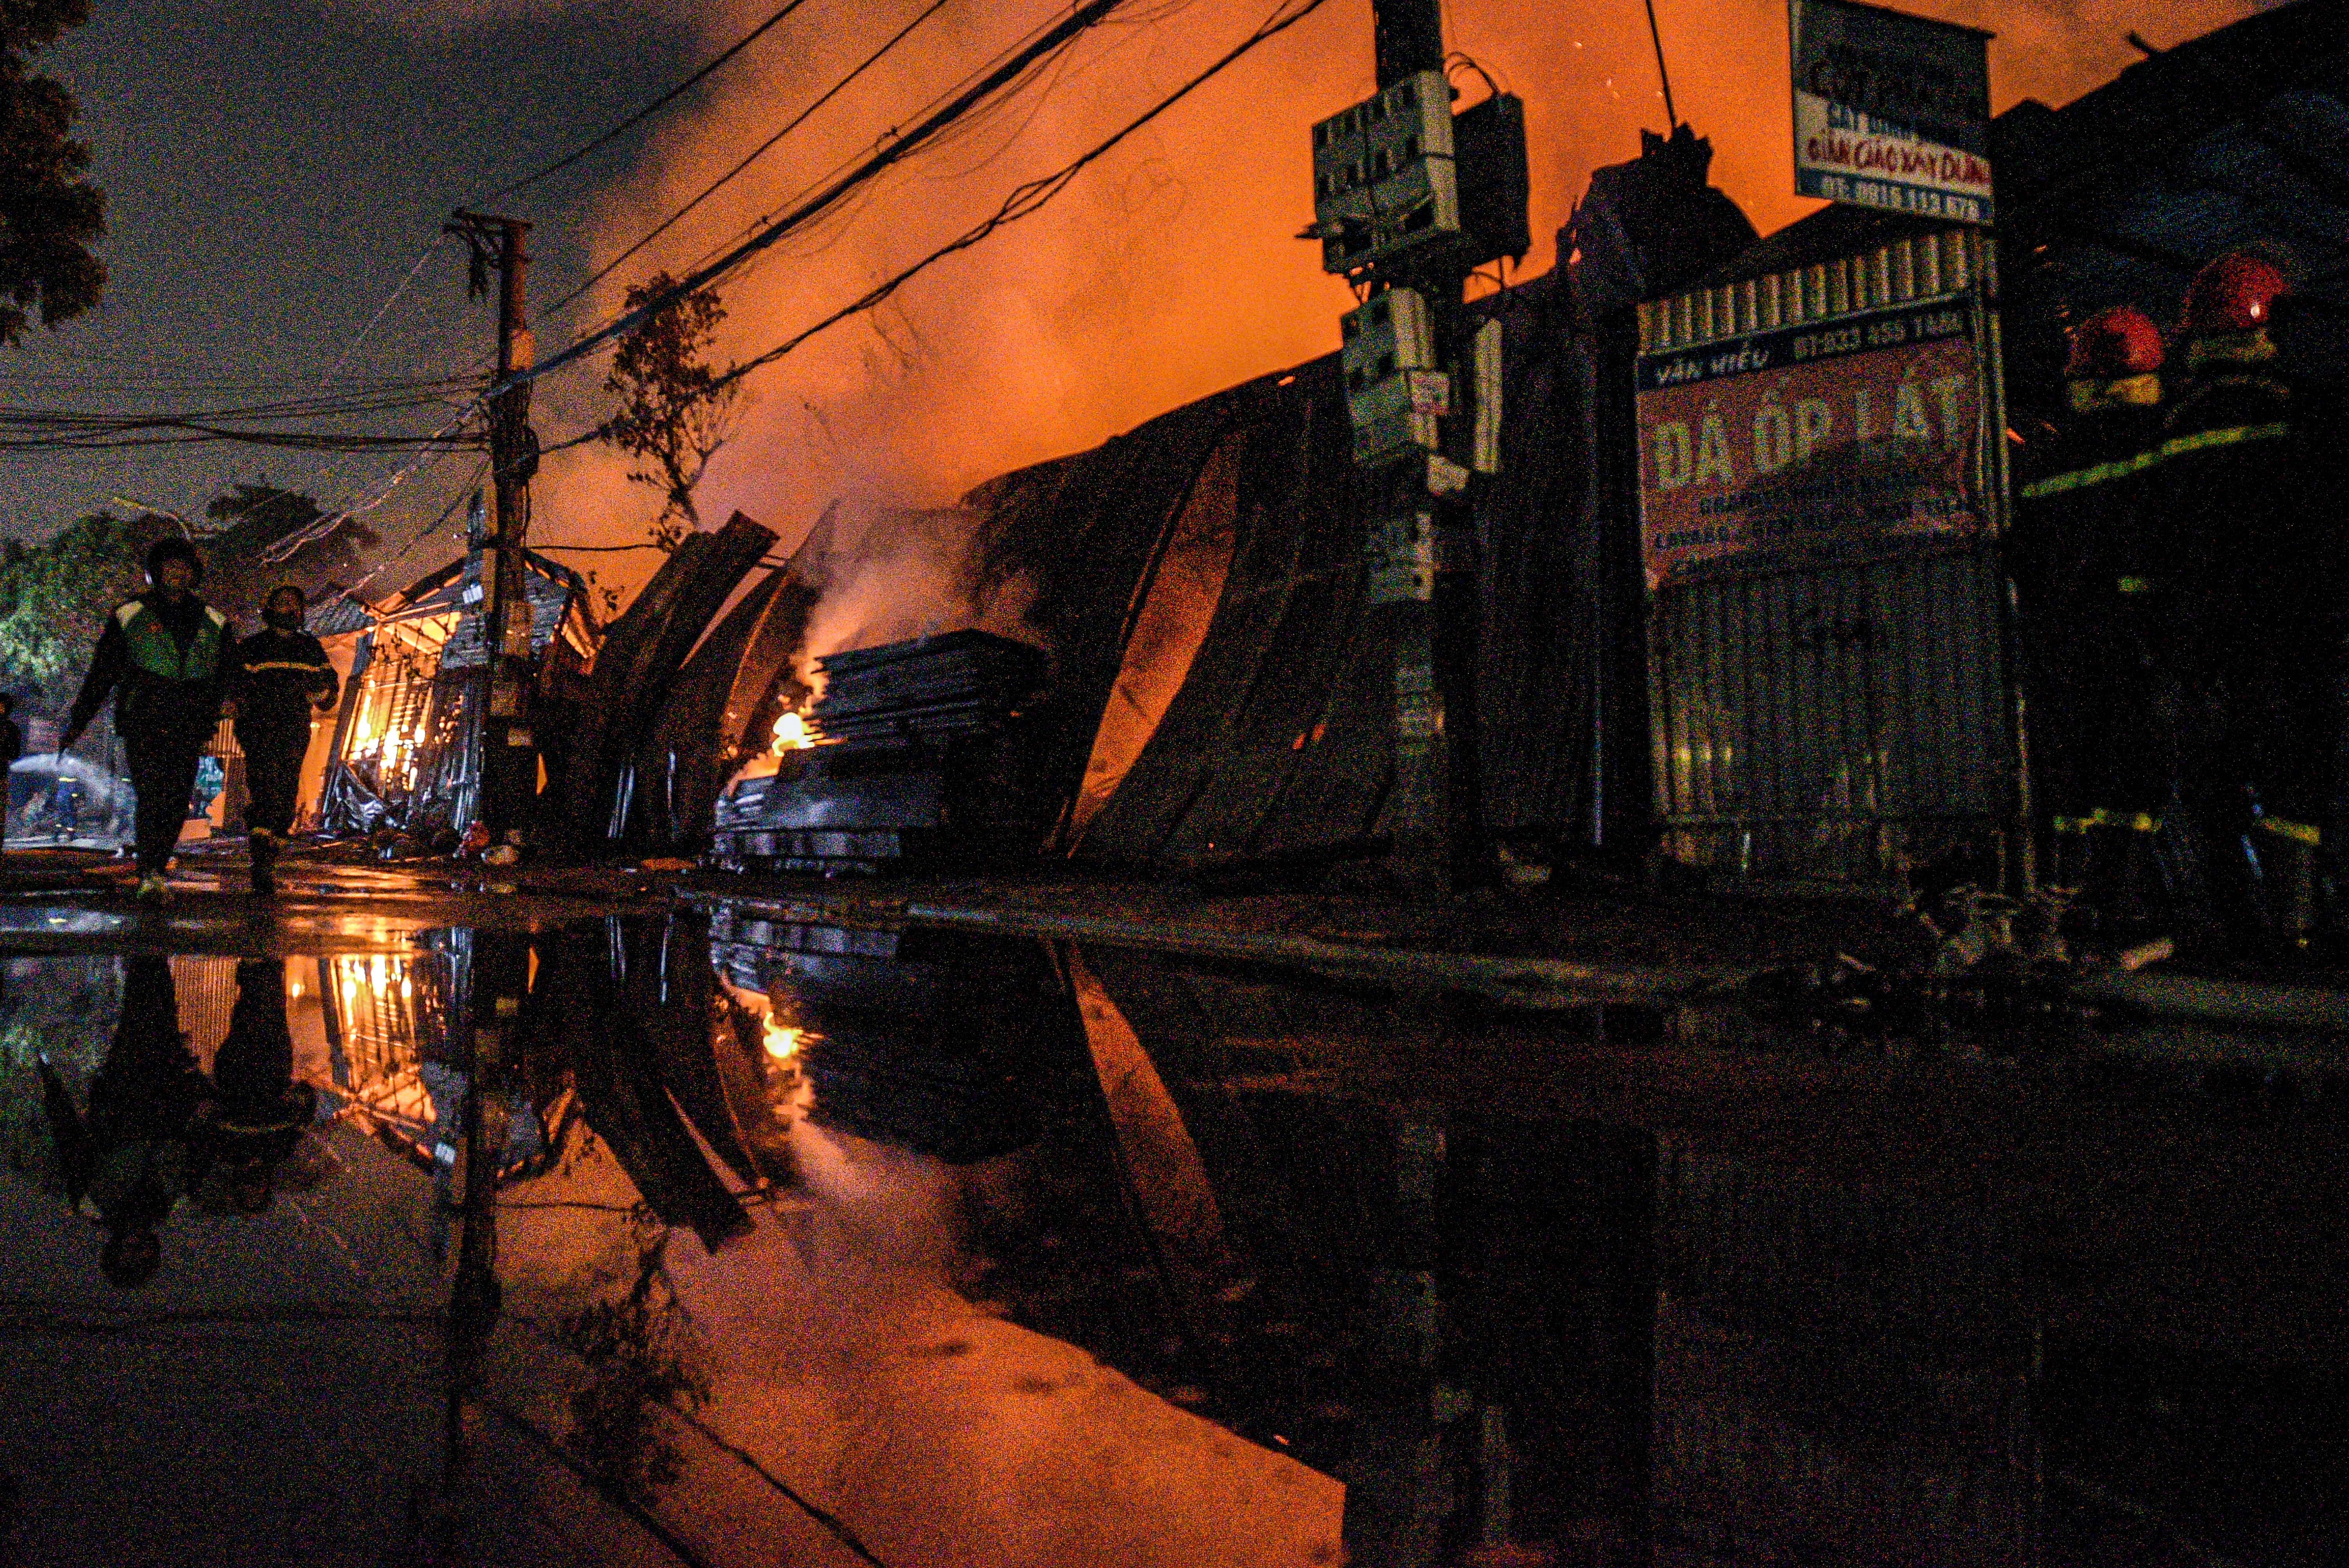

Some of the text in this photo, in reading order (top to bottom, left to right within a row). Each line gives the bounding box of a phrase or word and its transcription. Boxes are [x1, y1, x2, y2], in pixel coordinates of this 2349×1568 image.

[1655, 365, 1967, 490] ĐÁ ỐP LÁT
